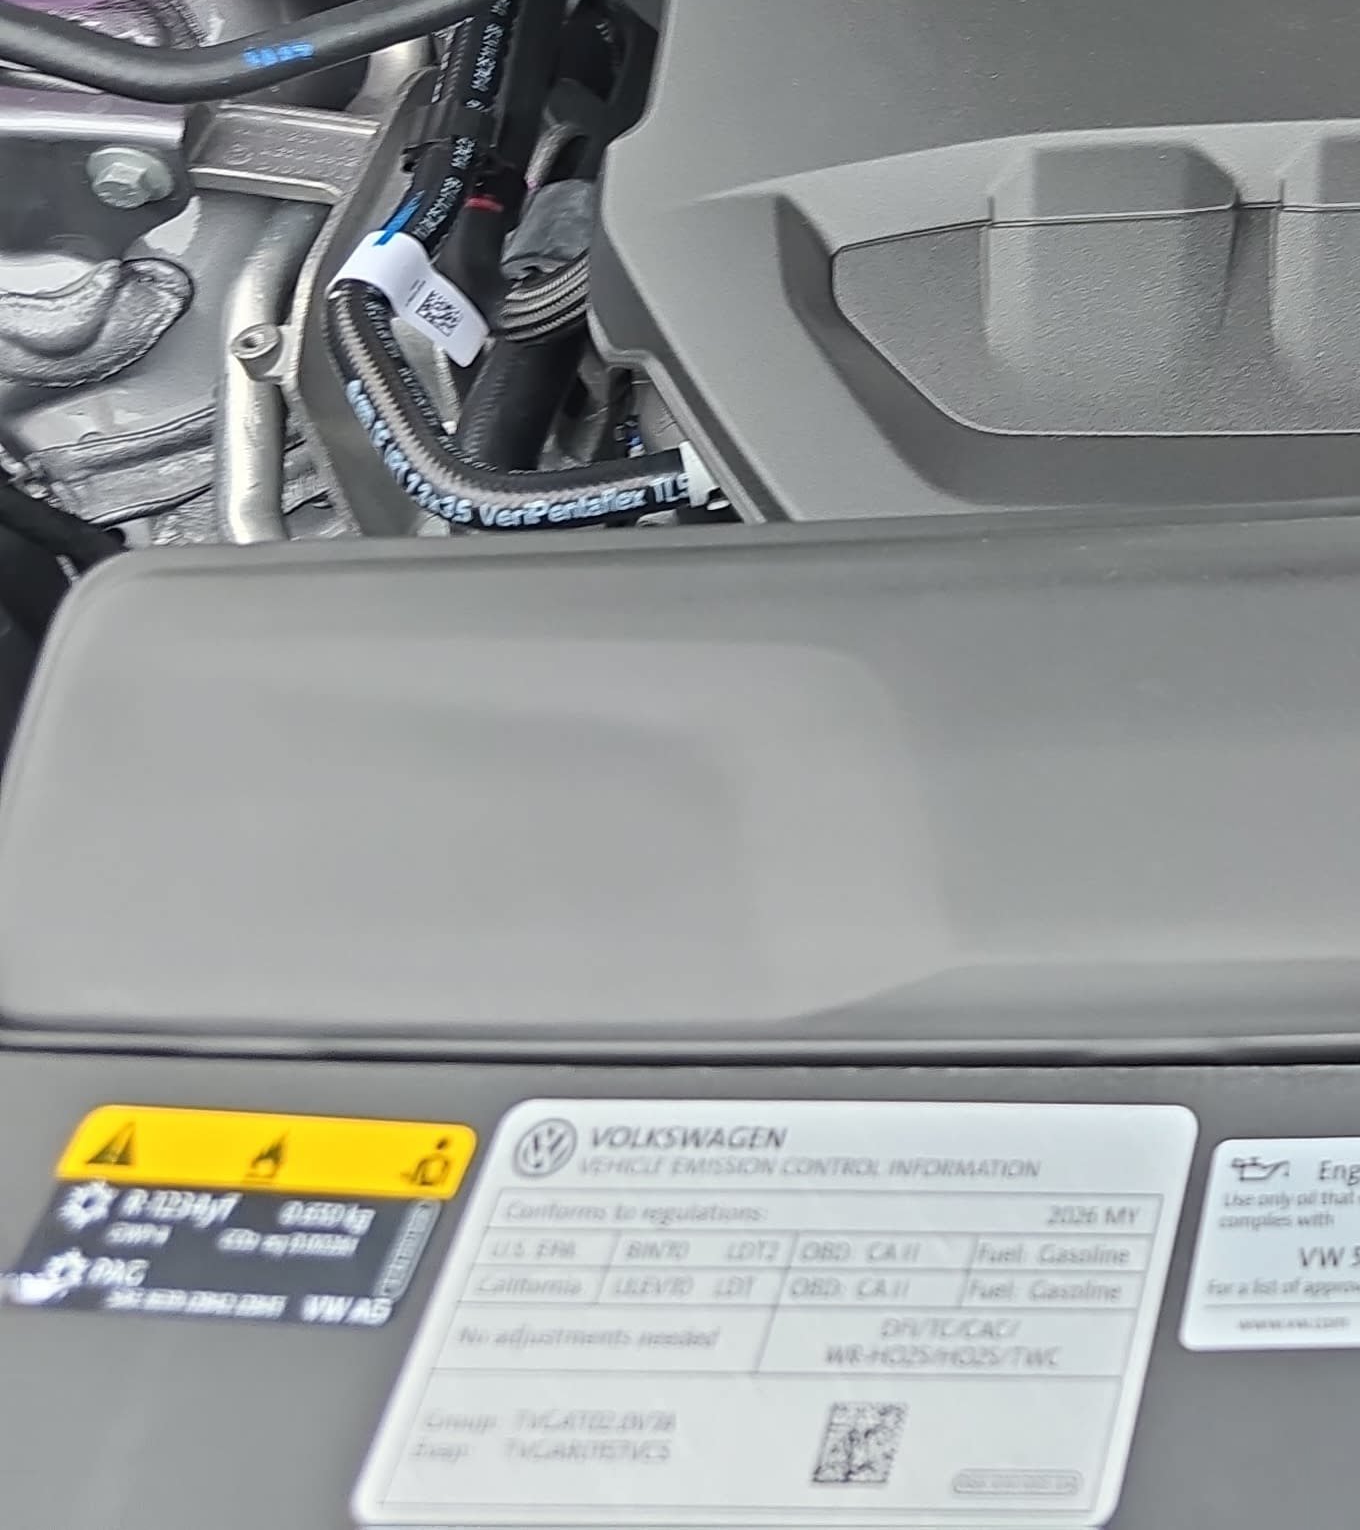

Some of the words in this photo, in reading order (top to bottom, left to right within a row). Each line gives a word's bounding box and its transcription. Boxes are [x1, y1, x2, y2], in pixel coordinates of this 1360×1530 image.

[590, 1126, 788, 1149] VOLKSWAGEN
[579, 1156, 662, 1176] VEHICLE
[671, 1156, 774, 1176] EMISSION
[782, 1156, 879, 1176] CONTROL
[888, 1158, 1041, 1177] INFORMATION
[504, 1200, 606, 1220] Conforms
[615, 1202, 636, 1220] to
[1223, 1192, 1251, 1208] Use
[1257, 1192, 1291, 1210] only
[1296, 1191, 1317, 1206] oil
[1321, 1190, 1354, 1206] that
[1047, 1205, 1099, 1225] 2026
[1104, 1205, 1142, 1224] MY
[1218, 1212, 1293, 1232] complies
[1297, 1212, 1335, 1227] with
[1039, 1244, 1131, 1266] Gasoline
[1299, 1246, 1346, 1267] VW
[475, 1276, 582, 1297] California
[1028, 1280, 1121, 1302] Gasoline
[1206, 1279, 1233, 1295] For
[1238, 1283, 1249, 1295] a
[1253, 1279, 1278, 1295] list
[1282, 1277, 1300, 1294] of
[1238, 1316, 1350, 1330] www.vw.com
[494, 1323, 632, 1349] adjustments
[637, 1326, 721, 1348] needed
